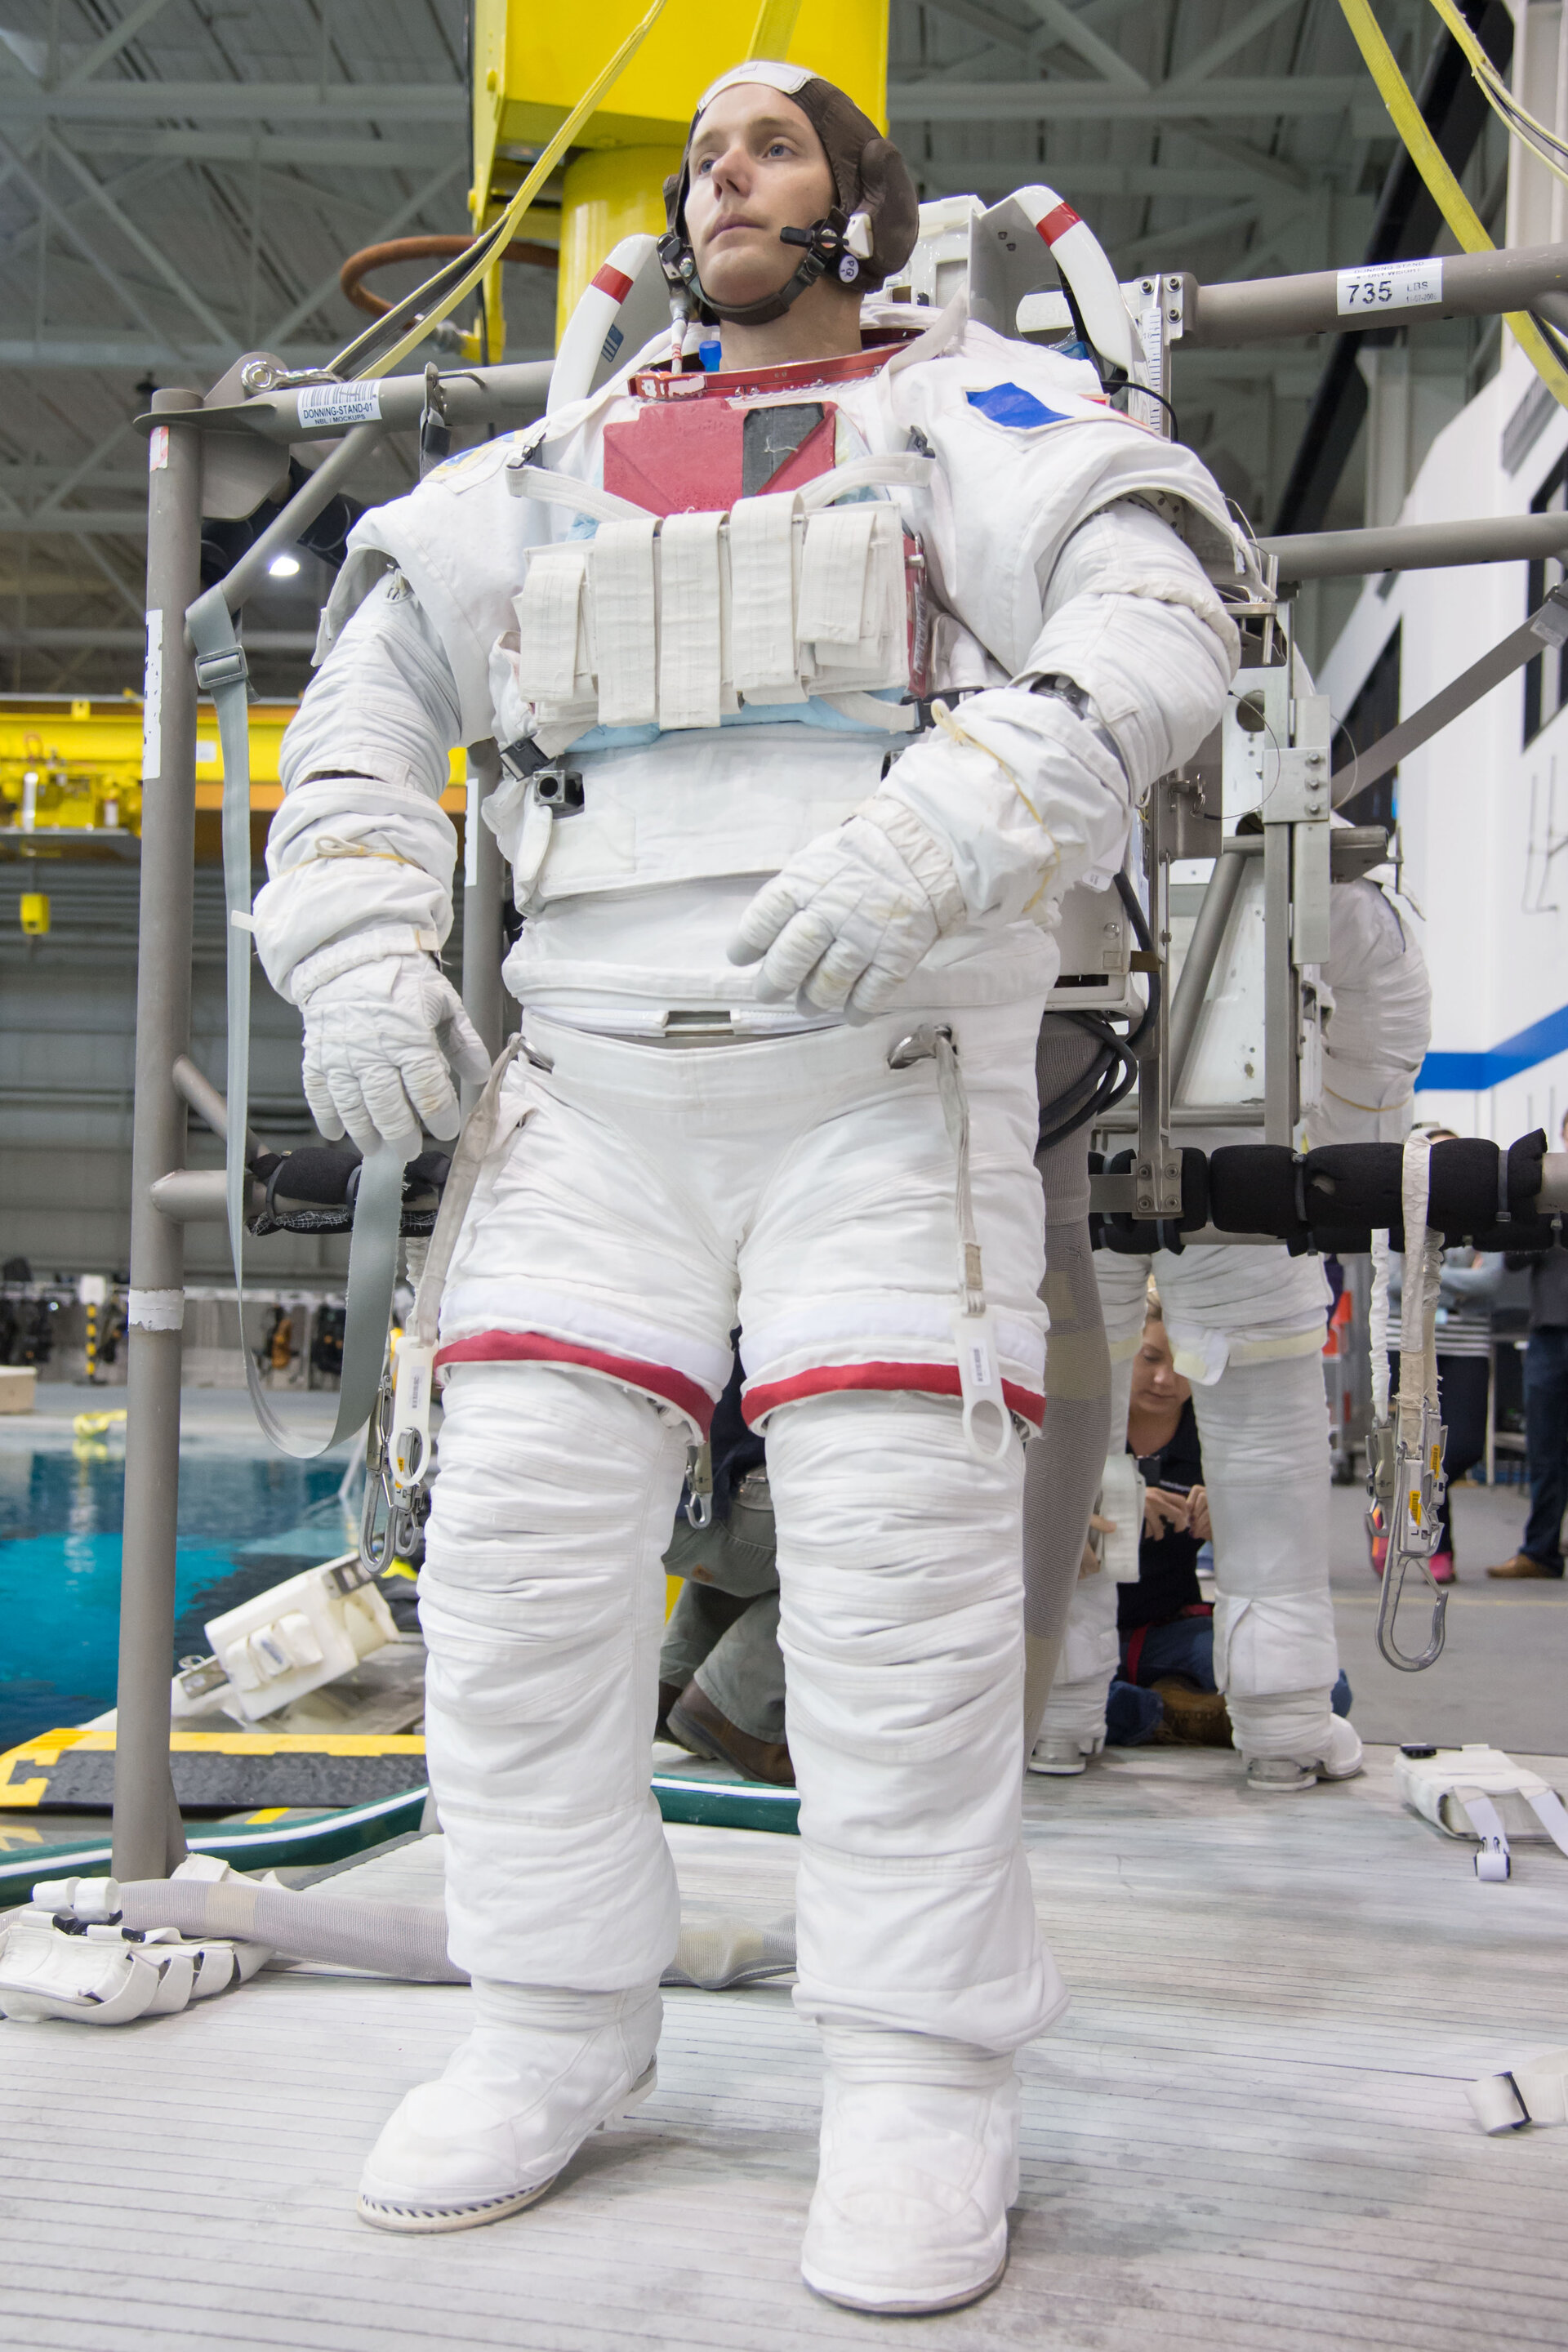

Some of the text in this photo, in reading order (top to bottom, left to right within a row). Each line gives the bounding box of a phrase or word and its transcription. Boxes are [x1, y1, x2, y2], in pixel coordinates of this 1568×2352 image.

[1346, 280, 1392, 305] 735
[303, 402, 373, 419] DONNING-STAND-01
[314, 417, 328, 425] NBL
[332, 413, 366, 423] MOCKUPS
